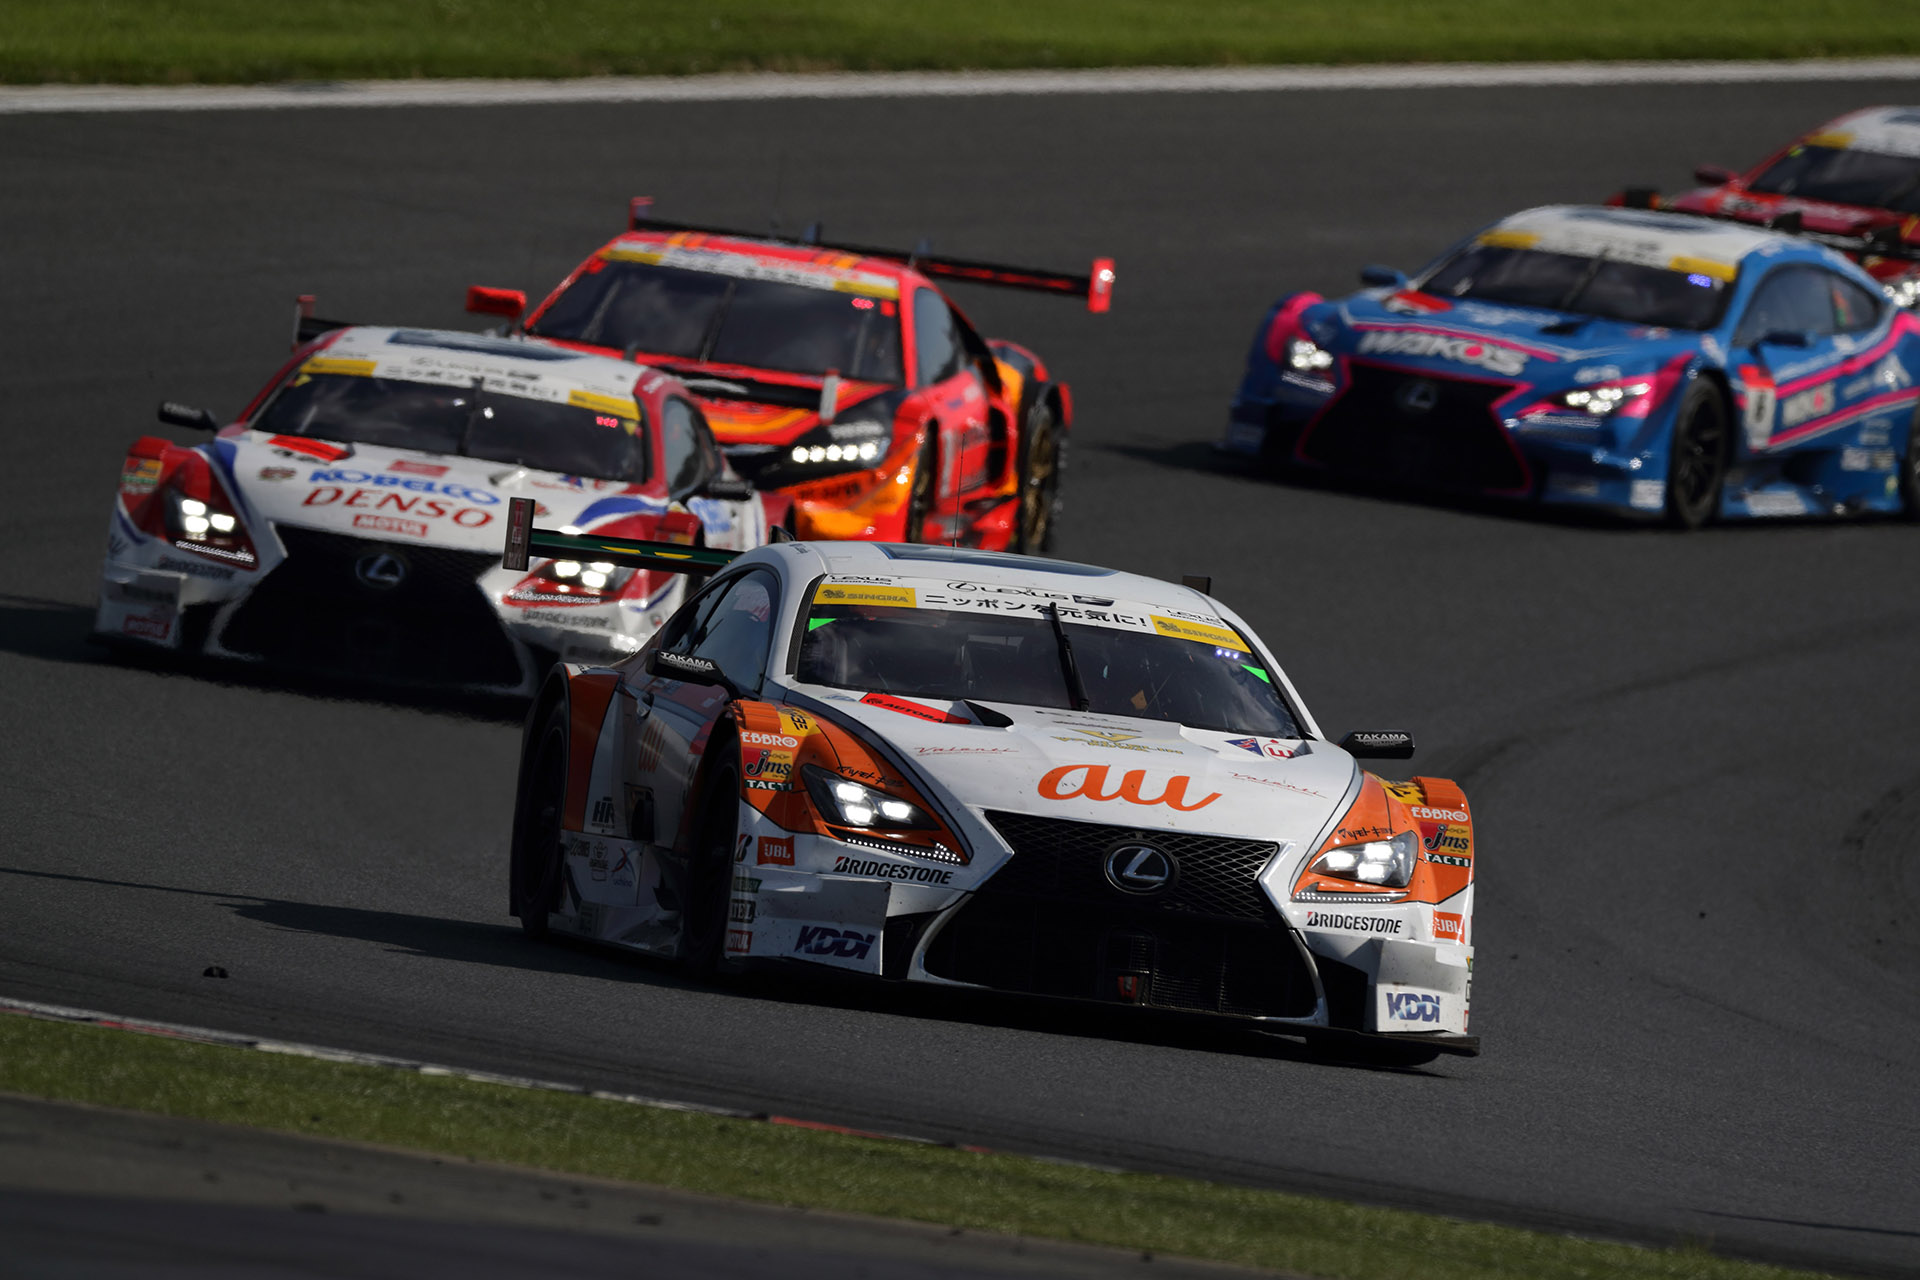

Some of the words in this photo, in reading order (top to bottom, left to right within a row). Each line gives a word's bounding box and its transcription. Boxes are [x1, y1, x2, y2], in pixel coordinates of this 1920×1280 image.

[309, 469, 501, 506] KOBELCO
[302, 486, 494, 528] DENSO
[847, 592, 909, 603] SINGHA
[981, 587, 1068, 600] LEXUS
[661, 651, 716, 670] TAKAMA
[741, 731, 798, 748] EBBRO
[1354, 733, 1410, 741] TAKAMA
[745, 750, 792, 777] jms
[747, 779, 793, 792] TACTI
[1037, 764, 1223, 812] au
[1411, 806, 1469, 822] EBBRO
[1423, 824, 1469, 850] jms
[1424, 851, 1469, 867] TACTI
[833, 856, 954, 884] BRIDGESTONE
[1306, 912, 1402, 934] BRIDGESTONE
[1437, 916, 1464, 932] JBL
[794, 925, 876, 960] KDDI
[1386, 992, 1440, 1023] KDDI
